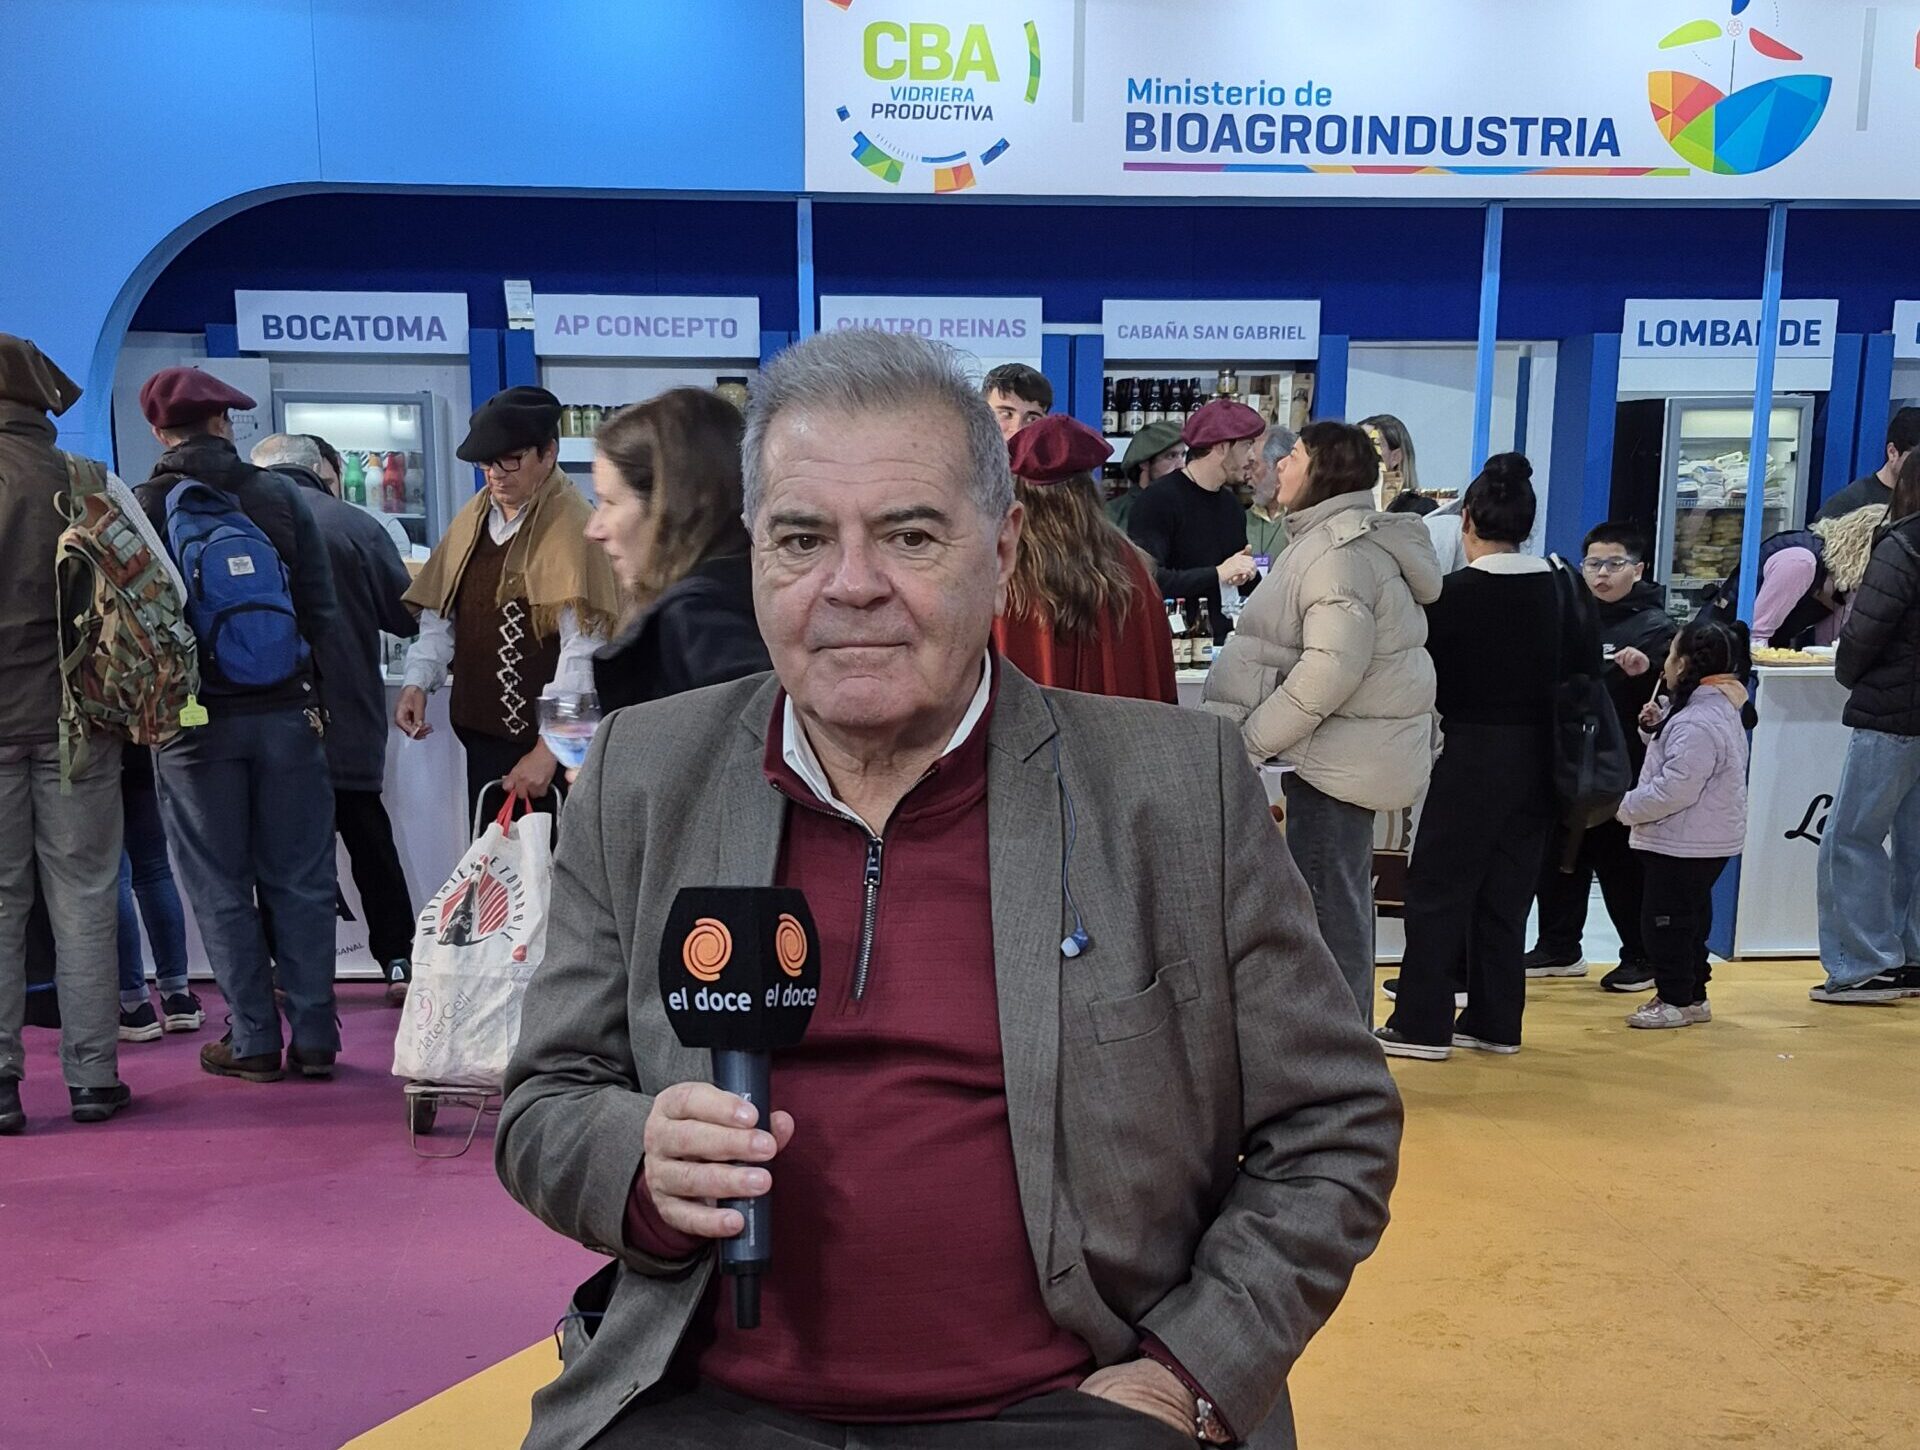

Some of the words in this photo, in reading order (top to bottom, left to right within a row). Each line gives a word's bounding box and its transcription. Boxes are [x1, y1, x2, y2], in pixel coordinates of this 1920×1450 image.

[863, 20, 1000, 83] CBA
[890, 86, 975, 103] VIDRIERA
[1126, 77, 1286, 107] Ministerio
[1294, 80, 1333, 107] de
[871, 102, 994, 122] PRODUCTIVA
[1125, 111, 1621, 157] BIOAGROINDUSTRIA
[261, 313, 448, 342] BOCATOMA
[554, 314, 590, 336] AP
[596, 314, 738, 340] CONCEPTO
[837, 317, 932, 337] CUATRO
[939, 318, 1026, 338] REINAS
[1117, 321, 1190, 340] CABAÑA
[1193, 324, 1229, 340] SAN
[1233, 325, 1307, 341] GABRIEL
[668, 987, 689, 1010] el
[694, 987, 752, 1012] doce
[765, 983, 780, 1008] el
[782, 983, 817, 1007] doce
[416, 990, 472, 1059] MaterCell
